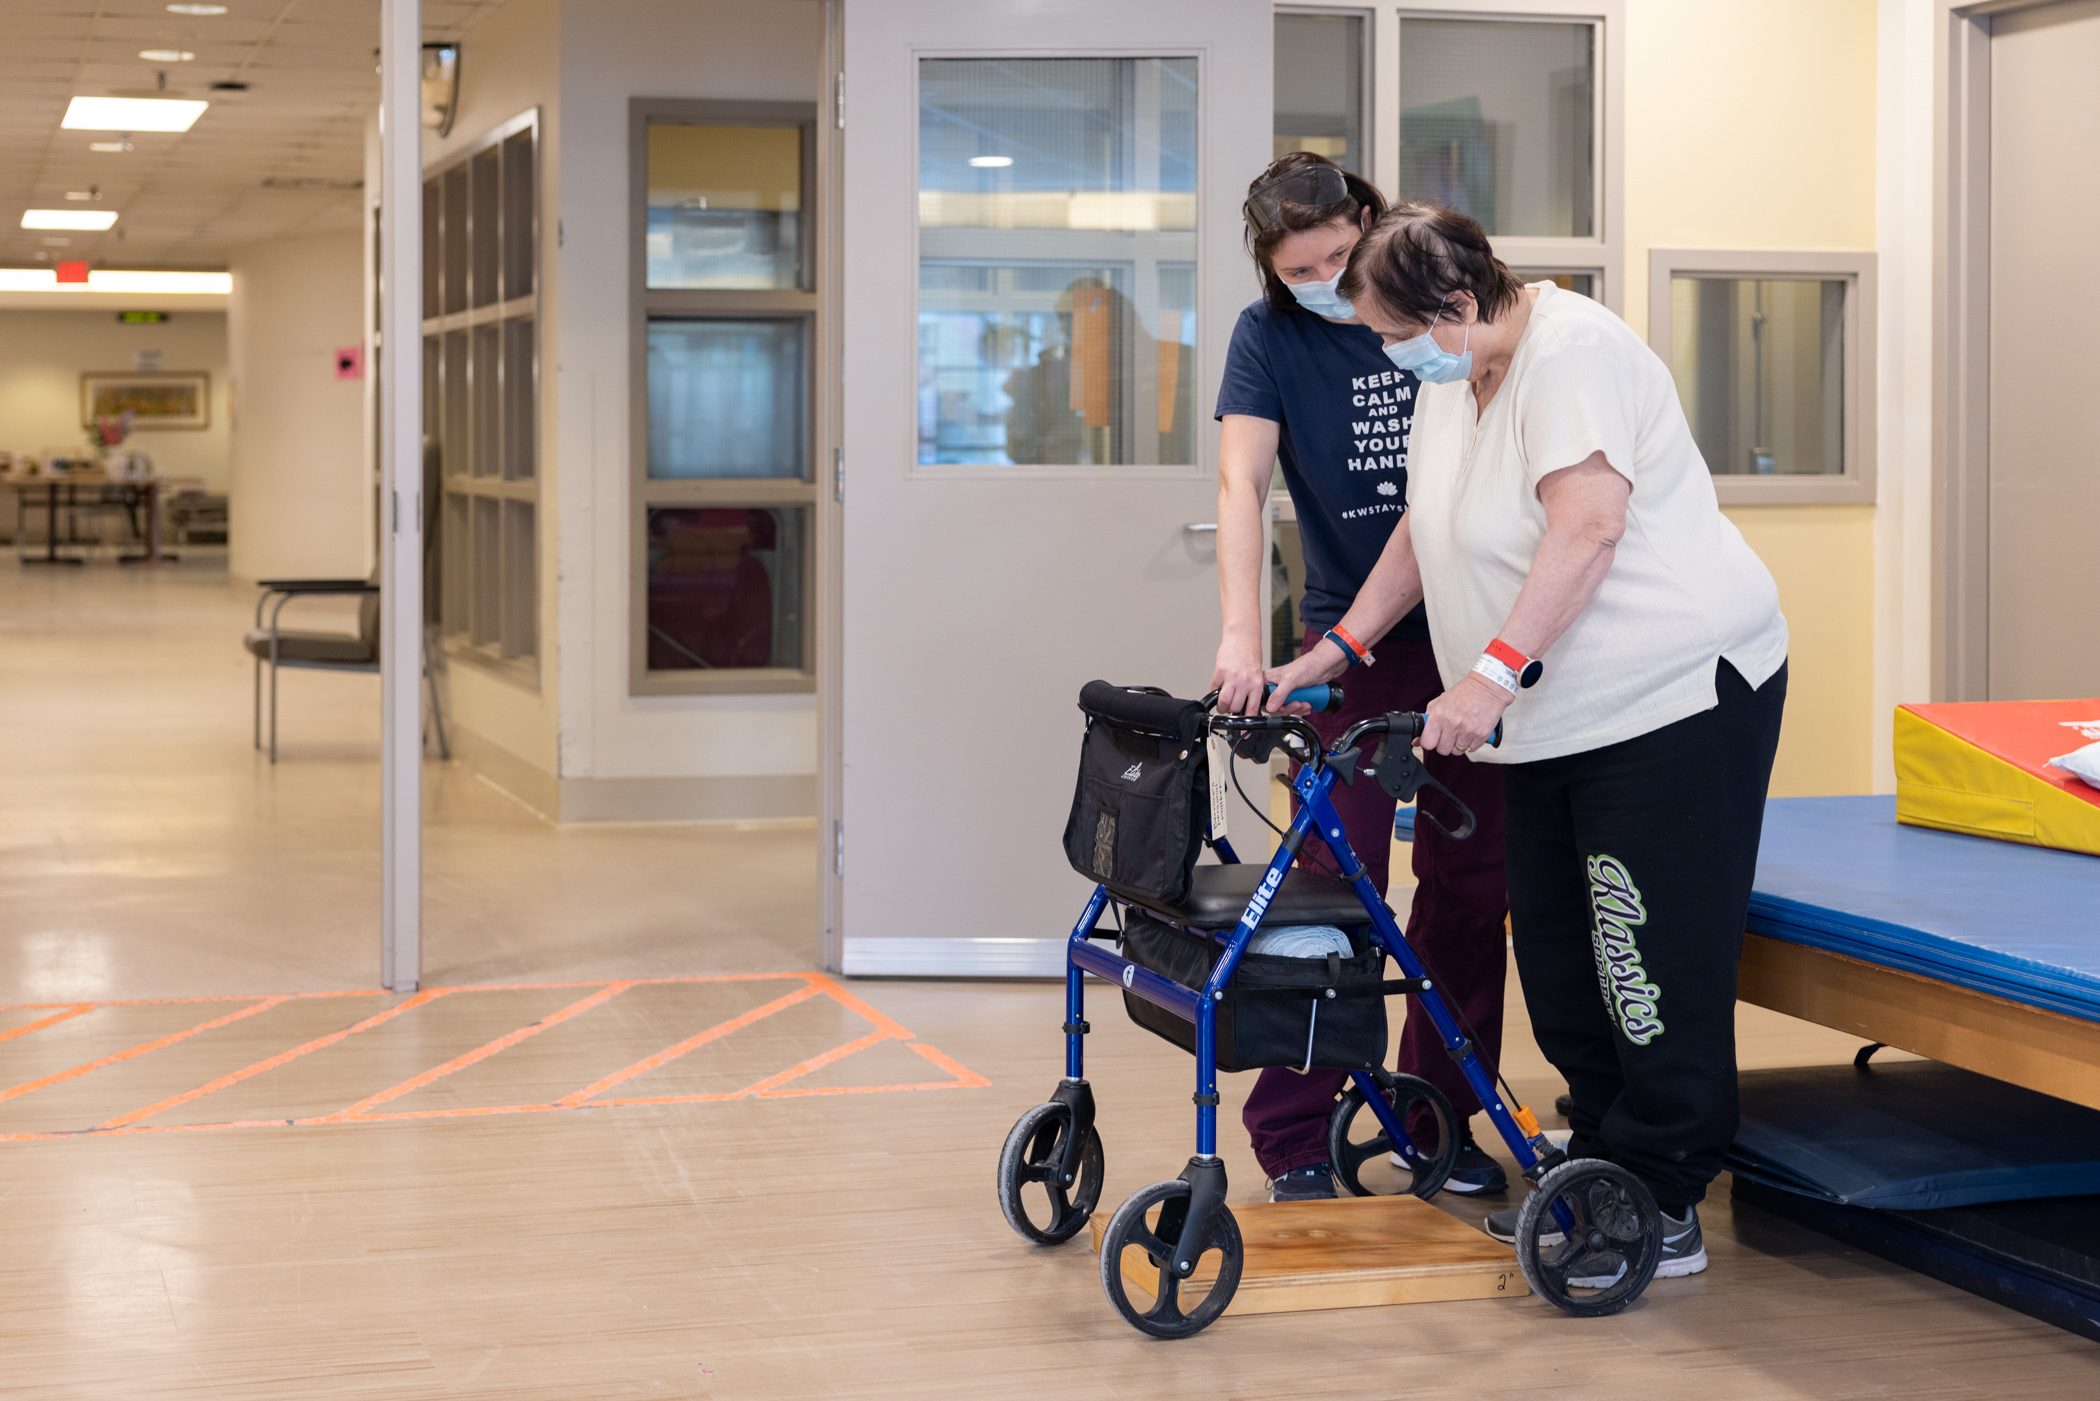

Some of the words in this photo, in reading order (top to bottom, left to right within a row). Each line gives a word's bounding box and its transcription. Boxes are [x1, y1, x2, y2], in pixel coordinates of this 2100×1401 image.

[1352, 371, 1405, 390] KEEP
[1352, 386, 1412, 407] CALM
[1368, 405, 1398, 417] AND
[1352, 415, 1413, 435] WASH
[1347, 454, 1407, 471] HAND
[1241, 867, 1282, 930] Elite
